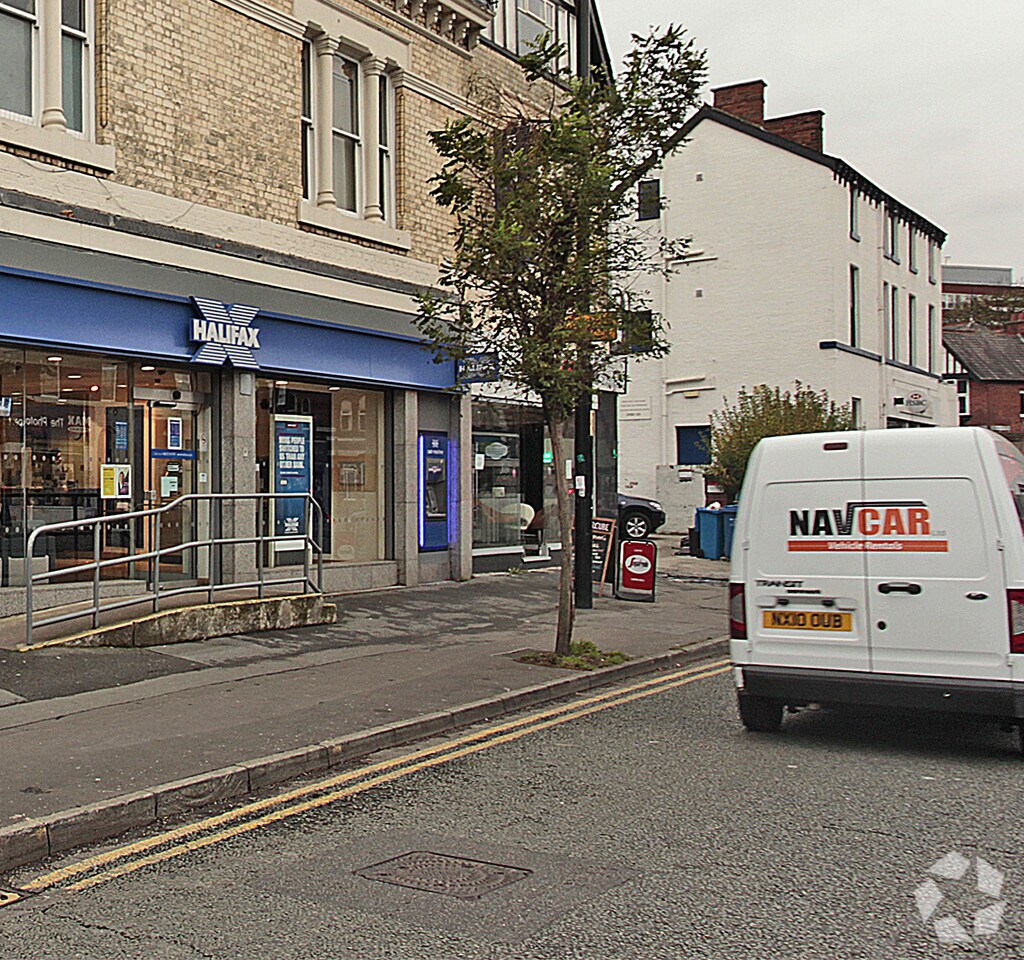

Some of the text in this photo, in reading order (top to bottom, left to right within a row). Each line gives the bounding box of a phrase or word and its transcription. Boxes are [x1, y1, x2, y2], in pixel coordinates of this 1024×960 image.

[193, 318, 261, 348] HALIFAX
[789, 502, 931, 536] NAVCAR
[827, 541, 904, 550] Vehicle Rentals
[754, 579, 805, 588] TRANSIT
[810, 613, 843, 628] OUB
